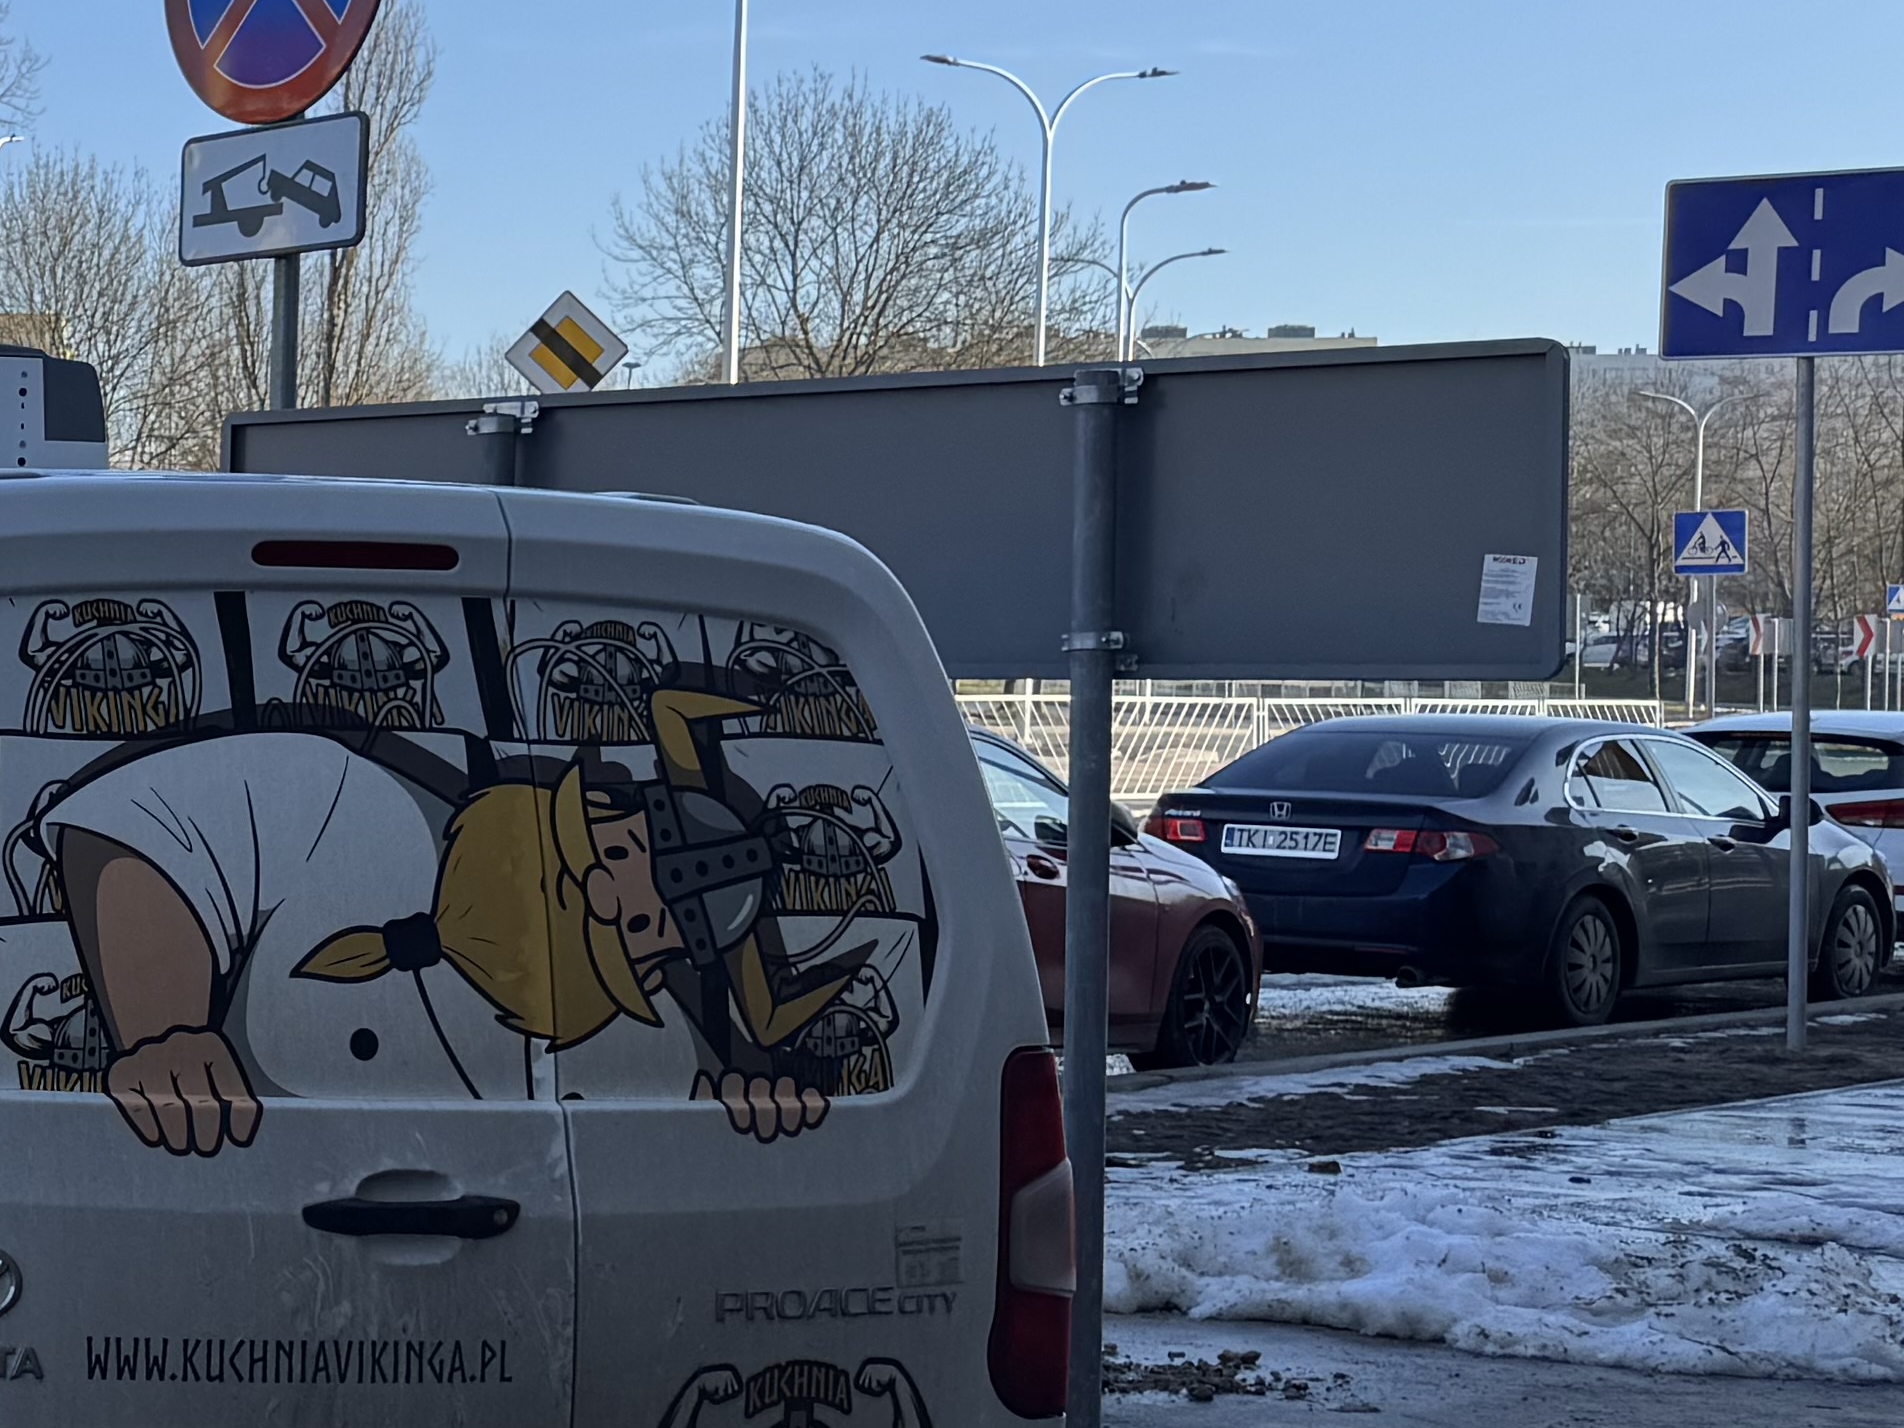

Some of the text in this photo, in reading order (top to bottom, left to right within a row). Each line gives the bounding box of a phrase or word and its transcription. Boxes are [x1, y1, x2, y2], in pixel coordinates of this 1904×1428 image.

[73, 601, 137, 627] KUCHNIA
[328, 602, 387, 627] KUCHNIA
[1237, 828, 1268, 847] TKI
[1276, 830, 1338, 853] 2517E
[715, 1286, 958, 1324] PROACE CITY
[85, 1335, 513, 1384] WWW.KUCHNIAVIKINGA.PL
[748, 1363, 851, 1414] KUCHNIA
